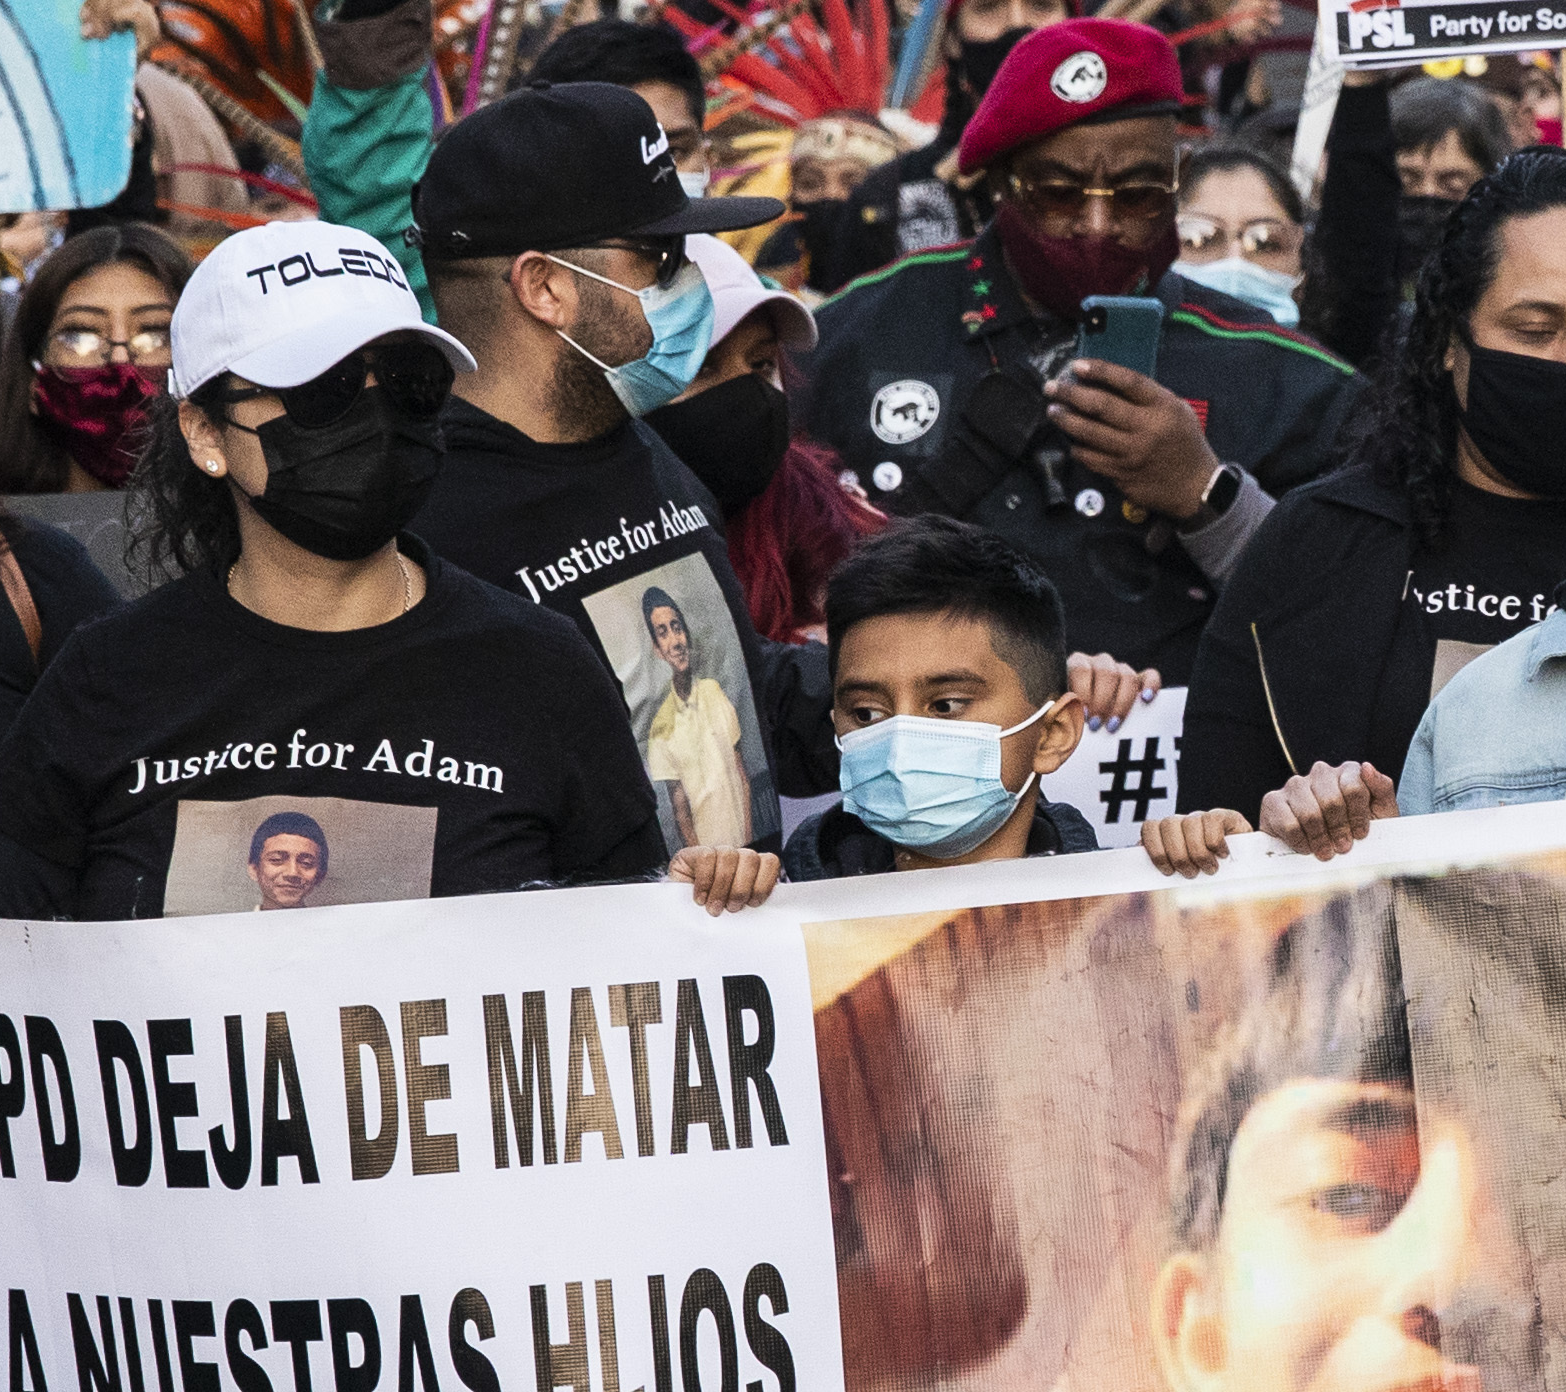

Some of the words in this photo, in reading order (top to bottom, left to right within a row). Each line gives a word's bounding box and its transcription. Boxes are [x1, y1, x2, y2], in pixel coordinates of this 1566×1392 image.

[1348, 9, 1415, 51] PSL
[1430, 15, 1493, 37] Party
[1498, 11, 1532, 32] for
[247, 246, 409, 297] TOLEDO
[516, 527, 628, 607] Justice
[618, 515, 660, 559] for
[659, 501, 711, 544] Adam
[1402, 570, 1522, 621] stice
[128, 728, 278, 796] Justice
[285, 730, 351, 772] for
[363, 738, 506, 795] Adam
[93, 1012, 319, 1190] DEJA
[340, 998, 459, 1181] DE
[482, 974, 789, 1169] MATAR
